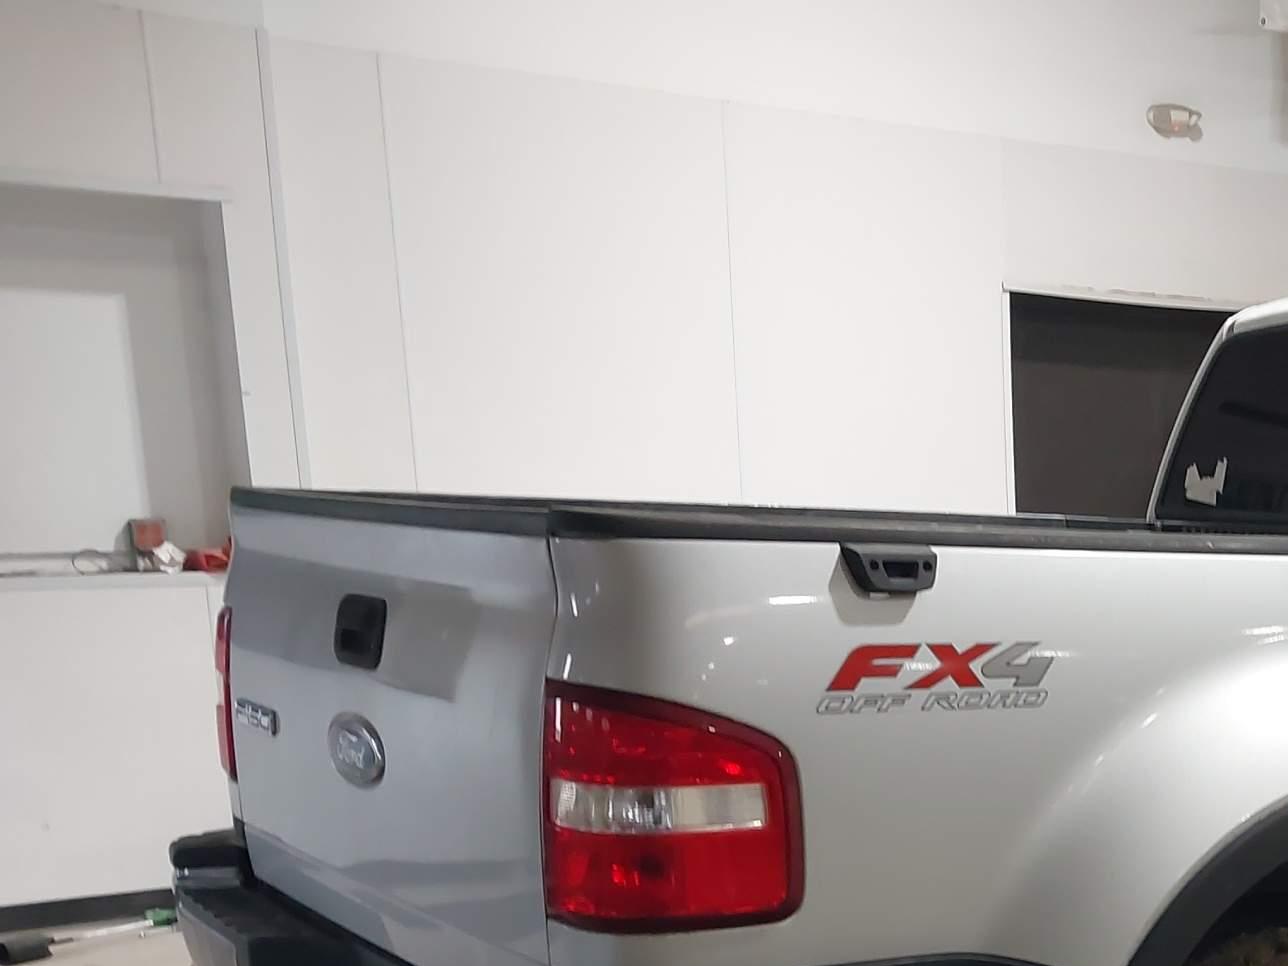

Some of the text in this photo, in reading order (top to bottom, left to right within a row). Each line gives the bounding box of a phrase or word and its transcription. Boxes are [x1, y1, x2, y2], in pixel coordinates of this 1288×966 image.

[825, 641, 1056, 692] FX4
[816, 691, 1049, 715] OFF ROAD
